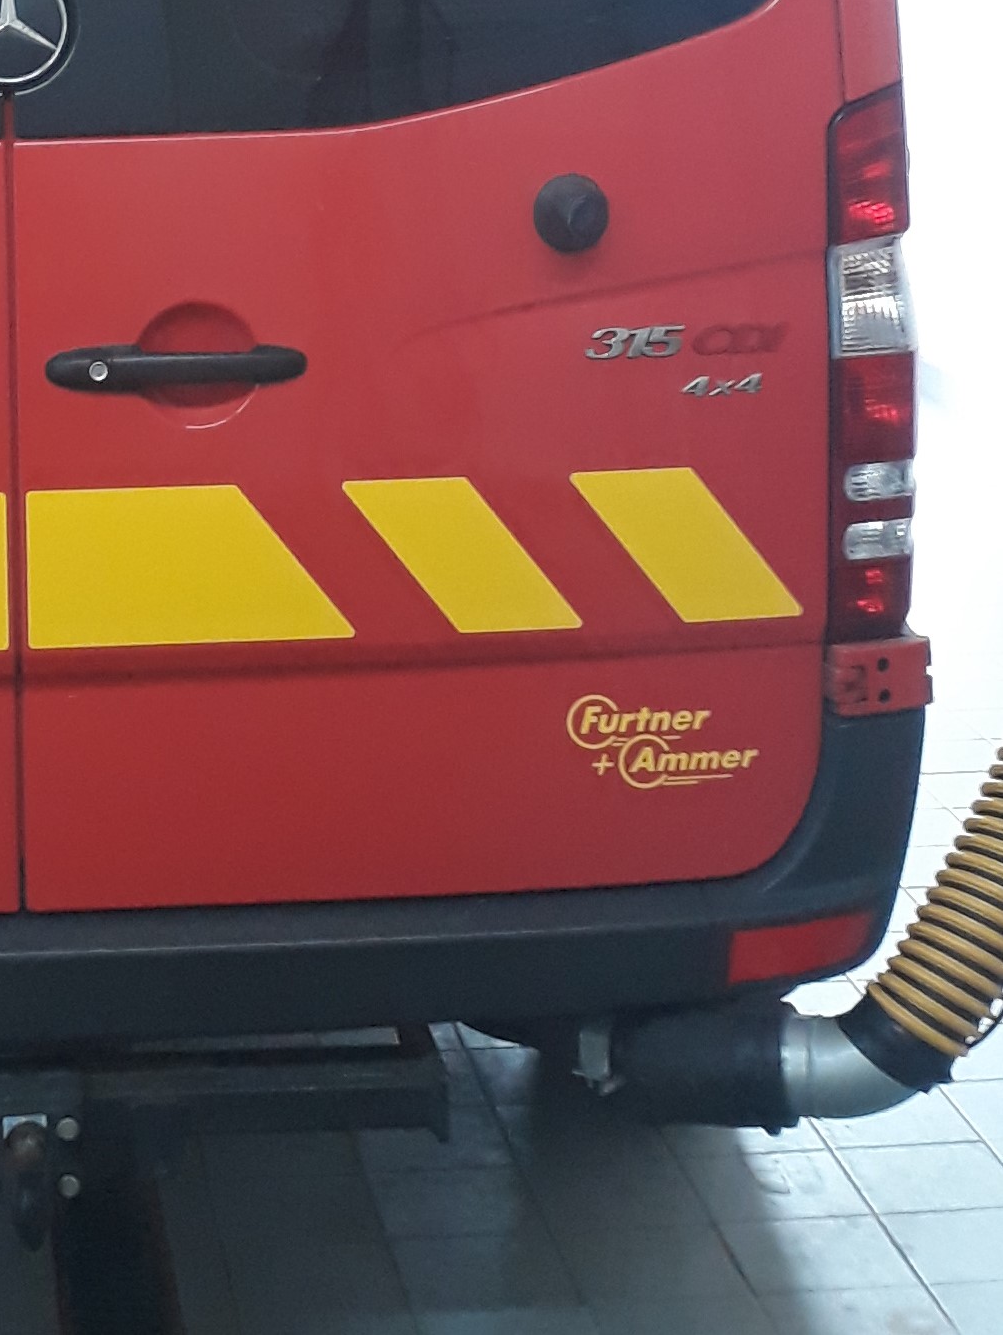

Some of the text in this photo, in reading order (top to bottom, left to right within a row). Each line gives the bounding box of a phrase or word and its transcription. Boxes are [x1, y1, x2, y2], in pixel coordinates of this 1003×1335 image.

[585, 325, 685, 359] 315
[681, 372, 763, 397] 4x4
[579, 705, 712, 735] Furtner
[628, 746, 760, 773] Ammer
